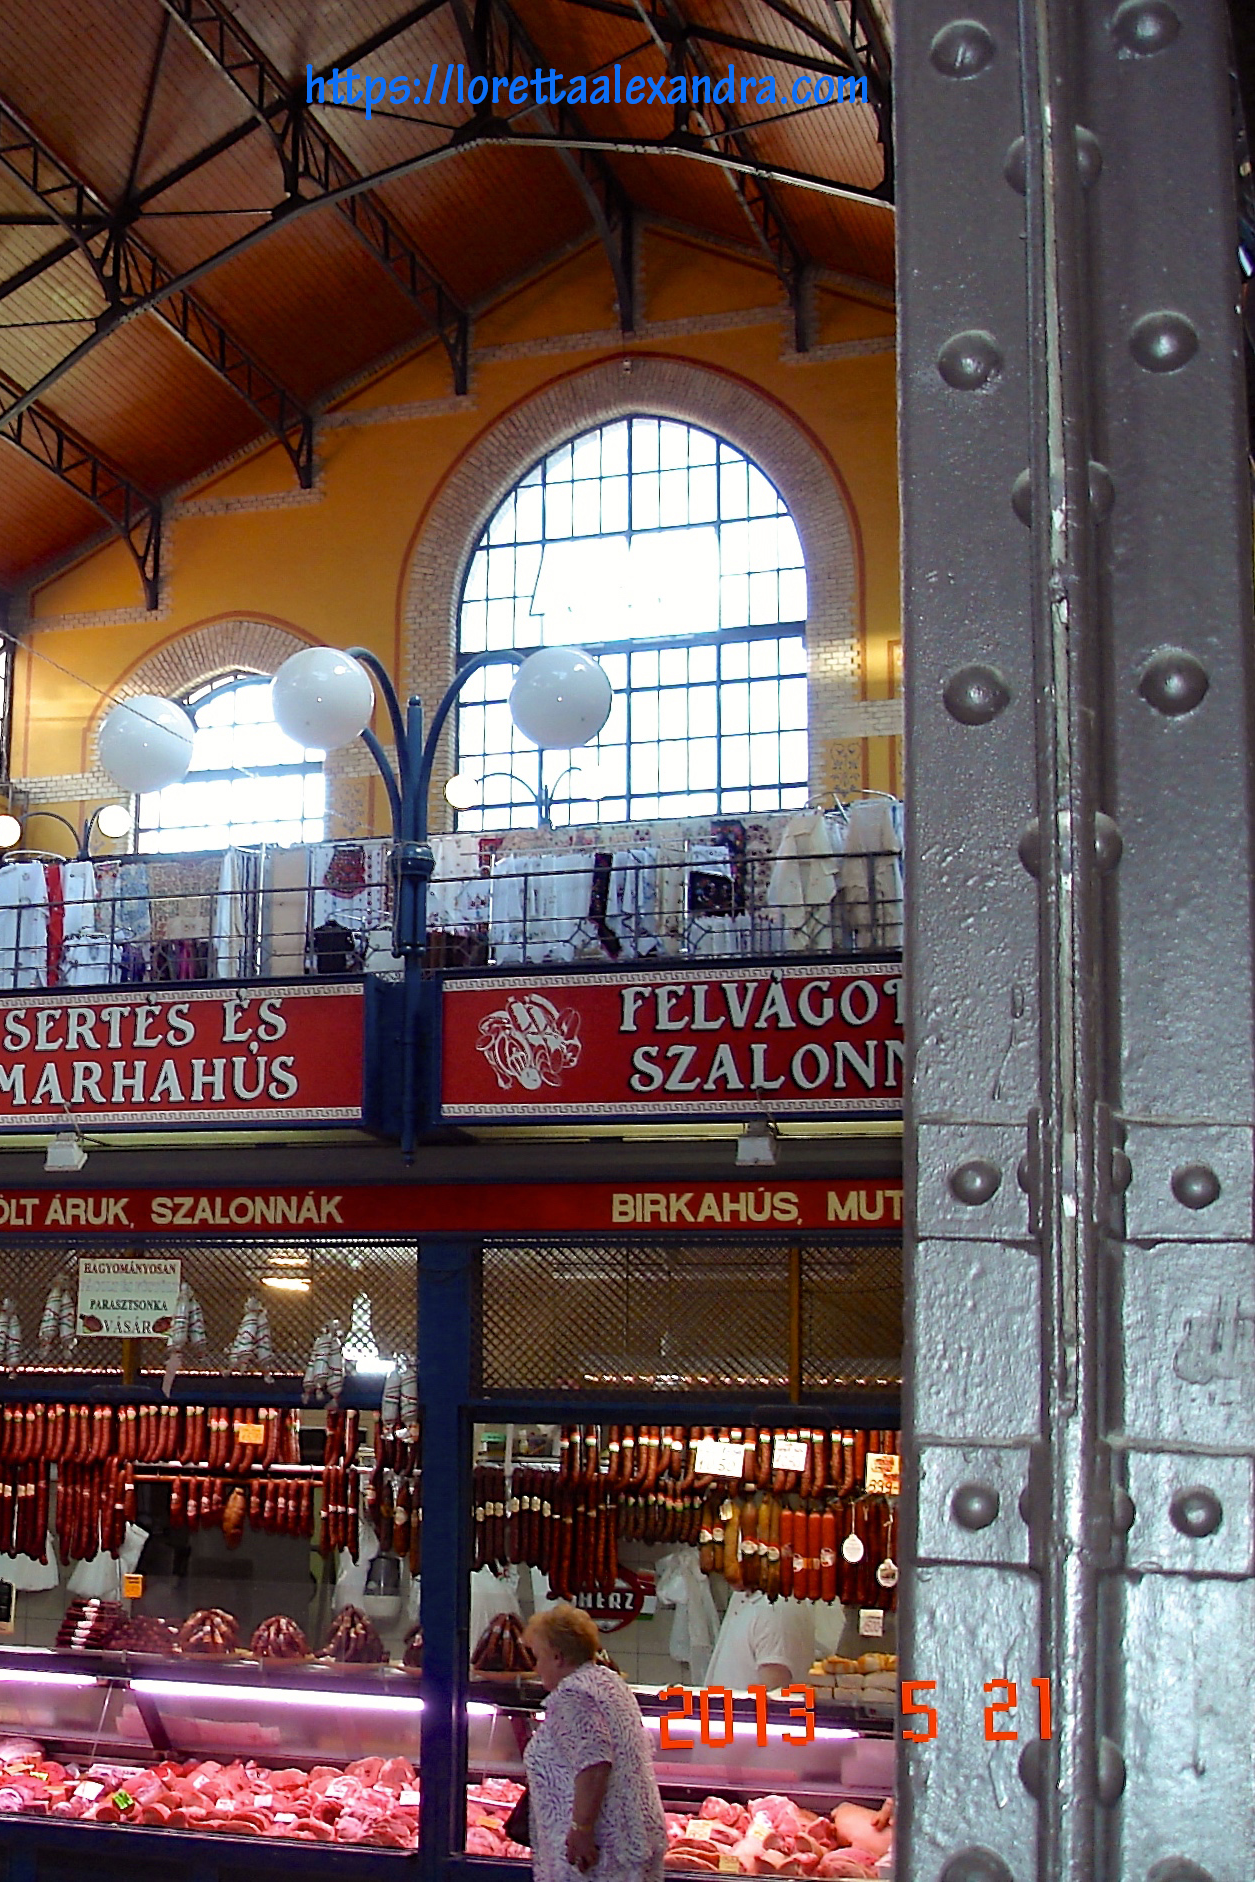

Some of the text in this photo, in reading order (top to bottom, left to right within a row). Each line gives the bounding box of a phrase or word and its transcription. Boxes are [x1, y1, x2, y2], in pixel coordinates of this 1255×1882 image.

[2, 988, 288, 1051] SERTÉS ÉS
[45, 1194, 135, 1229] ÁRUK,
[150, 1192, 344, 1225] SZALONNÁK
[612, 1187, 904, 1226] BIRKAHÚS, MUT
[89, 1298, 169, 1312] PARASZTSONKA
[103, 1315, 152, 1334] VÁSÁR
[577, 1591, 634, 1610] HERZ
